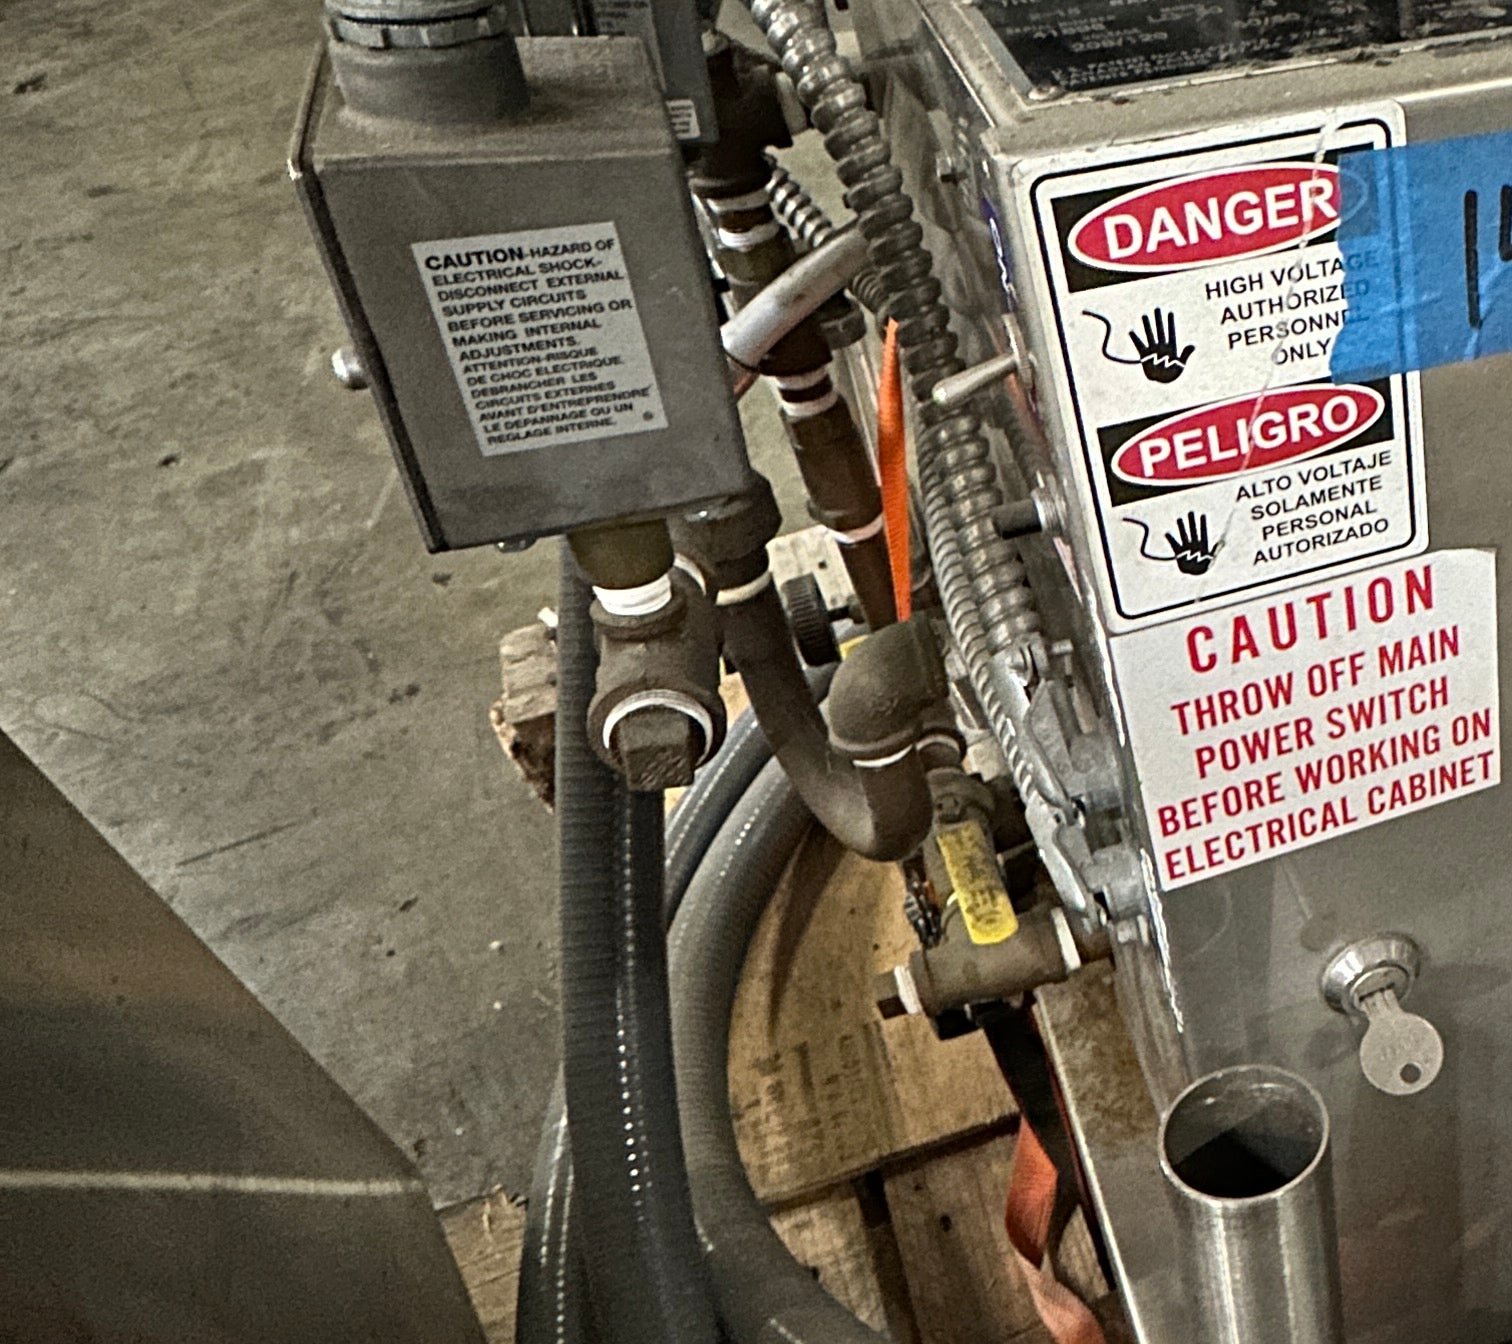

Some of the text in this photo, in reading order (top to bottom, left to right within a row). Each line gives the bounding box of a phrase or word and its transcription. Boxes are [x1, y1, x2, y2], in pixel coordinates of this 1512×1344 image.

[1104, 178, 1338, 259] DANGER
[595, 238, 614, 250] OF
[432, 266, 535, 286] ELECTRICAL
[437, 271, 623, 302] DISCONNECT EXTERNAL
[1205, 273, 1264, 300] HIGH
[442, 289, 586, 317] SUPPLY CIRCUITS
[448, 299, 632, 332] BEFORE SERVICING OR
[452, 319, 601, 346] MAKING INTERNAL
[1274, 338, 1330, 365] ONLY
[467, 376, 486, 386] DE
[490, 368, 532, 382] CHOC
[572, 372, 597, 383] LES
[475, 393, 541, 410] CIRCUITS
[480, 407, 522, 422] AVANT
[483, 423, 500, 433] LE
[614, 403, 633, 412] UN
[1139, 395, 1358, 477] PELIGRO
[1236, 450, 1391, 502] ALTO VOLTAJE
[1251, 475, 1382, 520] SOLAMENTE
[1262, 500, 1376, 541] PERSONAL
[1253, 518, 1389, 565] AUTORIZADO
[1186, 566, 1433, 671] CAUTION
[1170, 625, 1459, 736] THROW OFF MAIN
[1195, 676, 1448, 779] POWER SWITCH
[1158, 708, 1490, 837] BEFORE WORKING ON
[1165, 750, 1494, 880] ELECTRICAL CABINET
